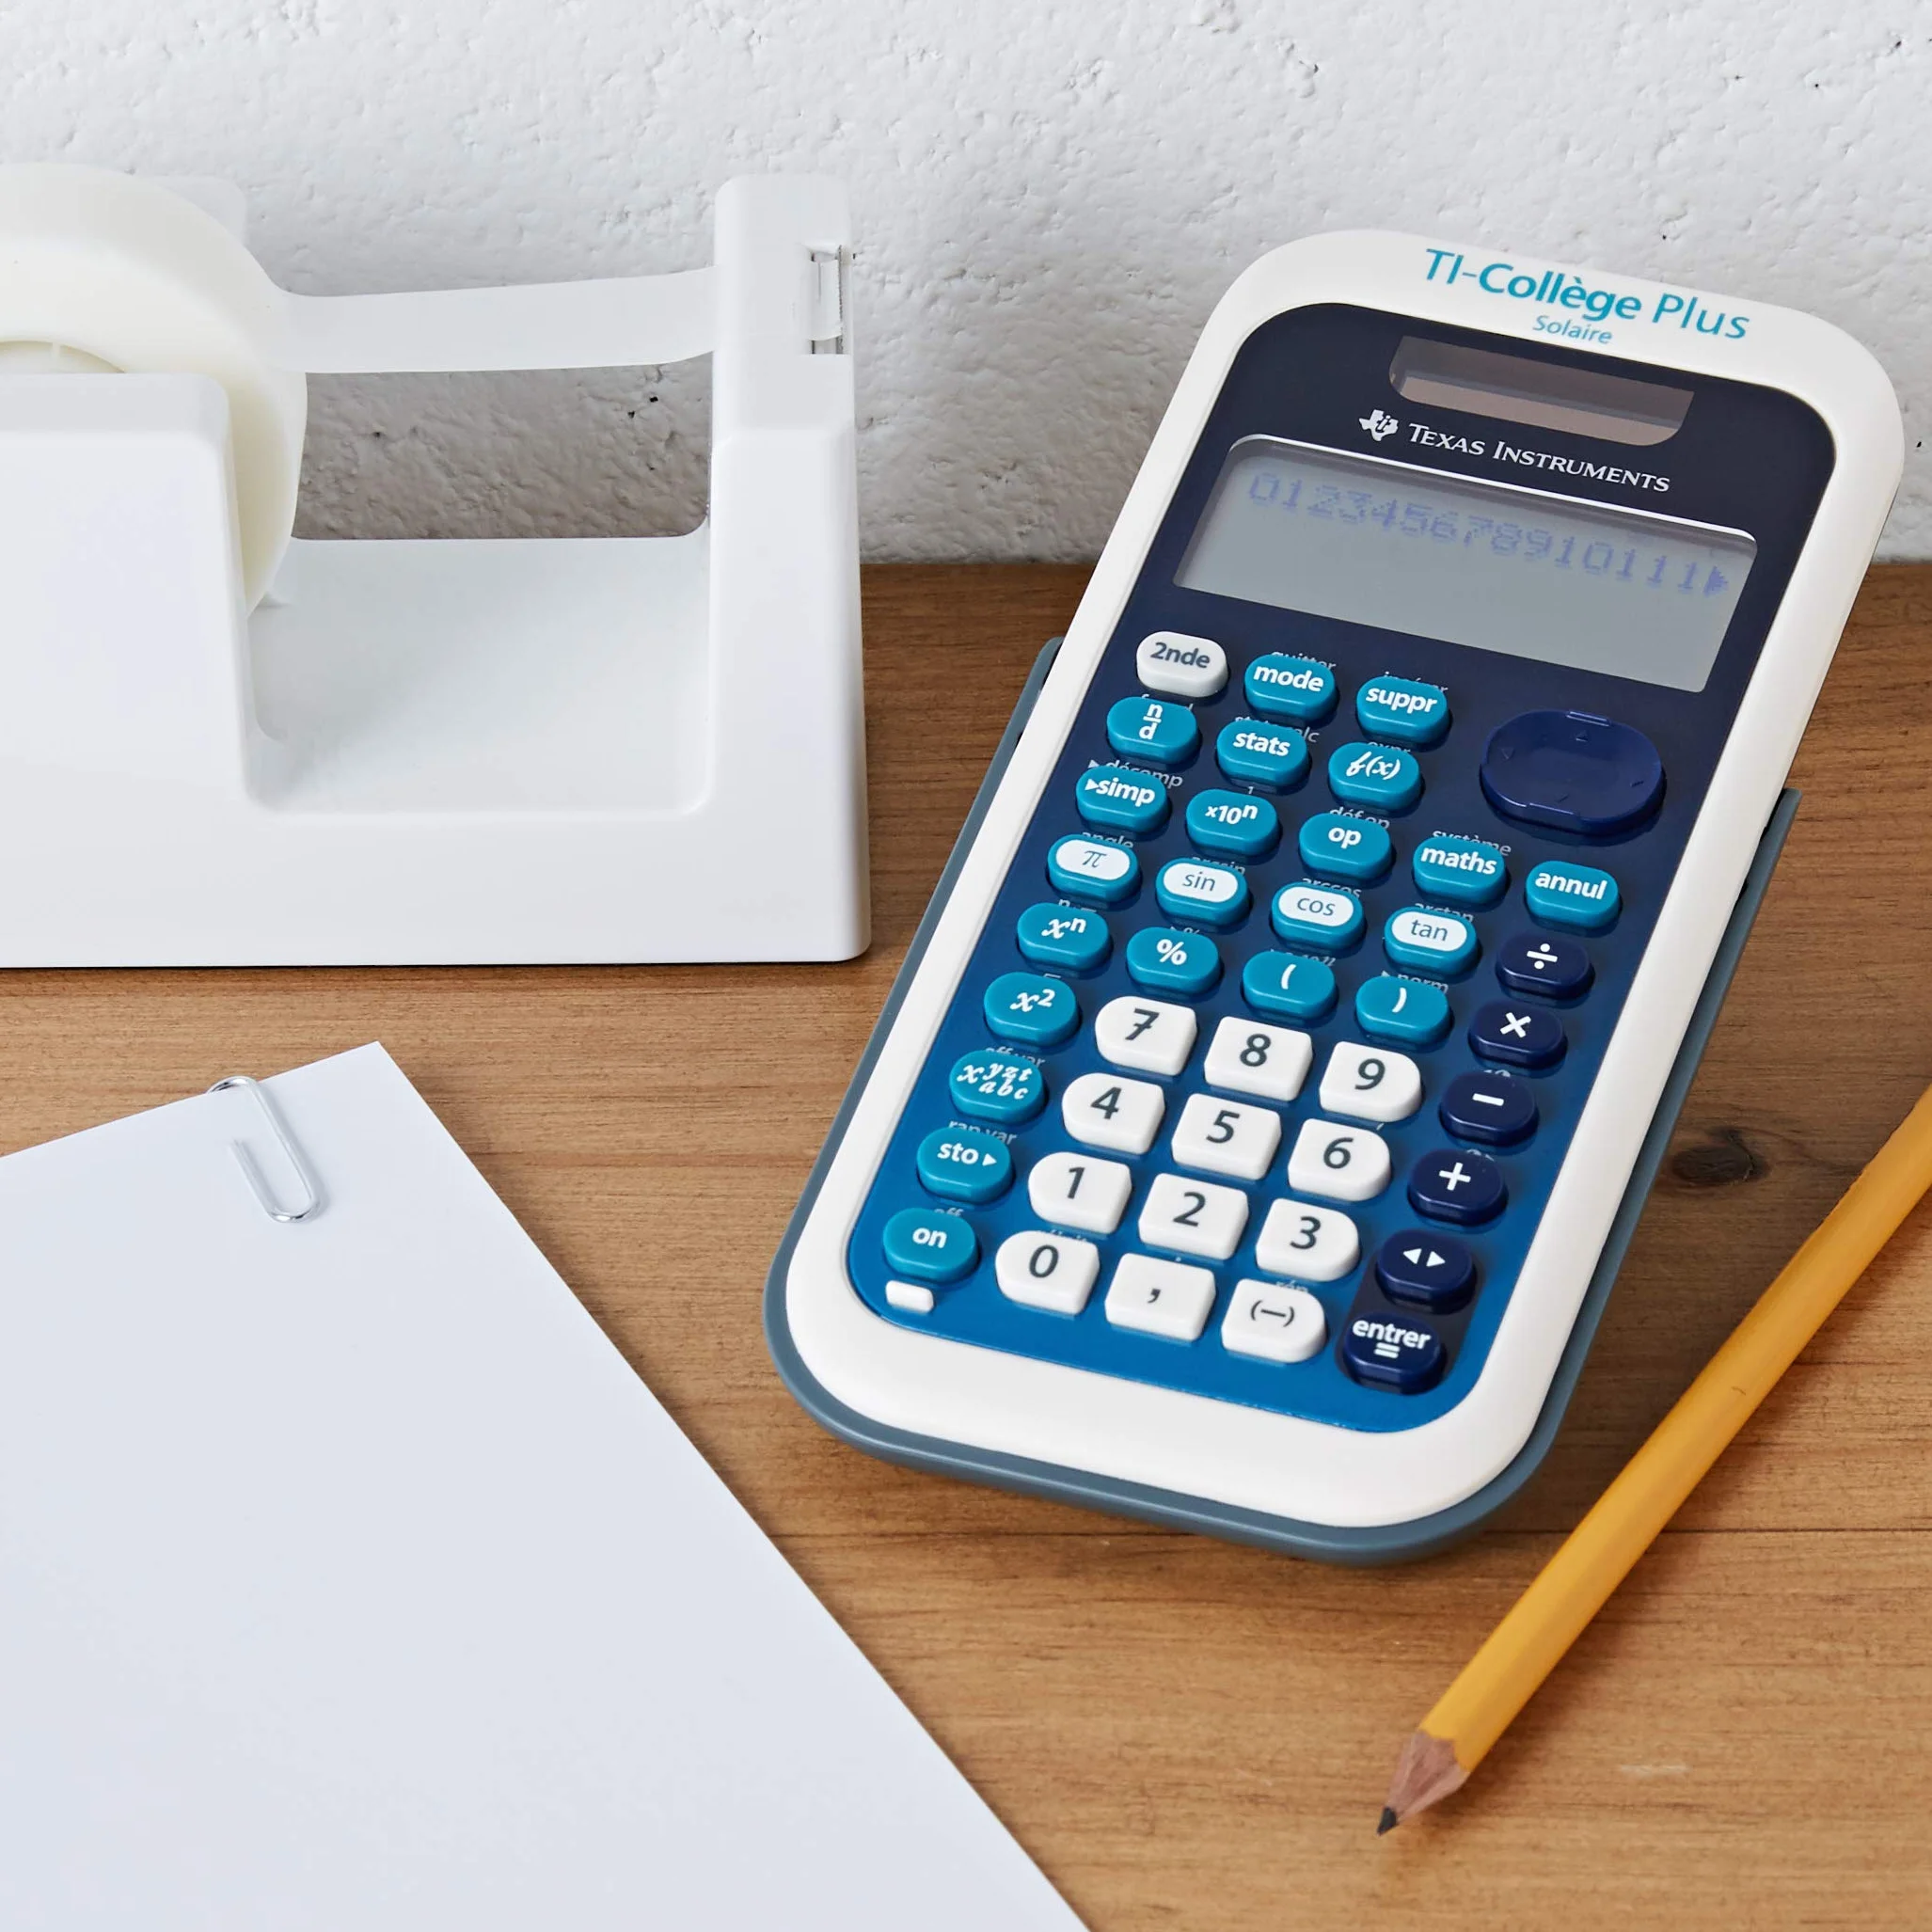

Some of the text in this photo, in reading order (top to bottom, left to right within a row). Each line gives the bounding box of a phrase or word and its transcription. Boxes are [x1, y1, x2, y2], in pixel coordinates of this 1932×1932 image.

[1426, 248, 1750, 340] TI-Collège Plus
[1533, 315, 1613, 344] Solaire
[1150, 641, 1211, 669] 2nde
[1253, 665, 1324, 692] mode
[1366, 687, 1438, 713] suppr
[1233, 732, 1291, 756] stats
[1096, 777, 1156, 807] simp
[1327, 827, 1362, 849] op
[1420, 847, 1497, 875] maths
[1182, 871, 1216, 892] sin
[1535, 871, 1607, 901] annul
[1296, 897, 1336, 916] cos
[1410, 919, 1449, 941] tan
[1156, 938, 1187, 966] %
[1280, 963, 1297, 990] (
[1391, 988, 1408, 1013] )
[1124, 1007, 1160, 1041] 7
[1239, 1033, 1272, 1067] 8
[1354, 1057, 1386, 1090] 9
[1090, 1086, 1122, 1119] 4
[1205, 1110, 1241, 1144] 5
[937, 1143, 979, 1165] sto
[1322, 1136, 1354, 1169] 6
[1067, 1166, 1085, 1199] 1
[1172, 1191, 1207, 1227] 2
[912, 1227, 947, 1249] on
[1290, 1215, 1322, 1250] 3
[1028, 1244, 1059, 1278] 0
[1352, 1318, 1432, 1351] entrer
